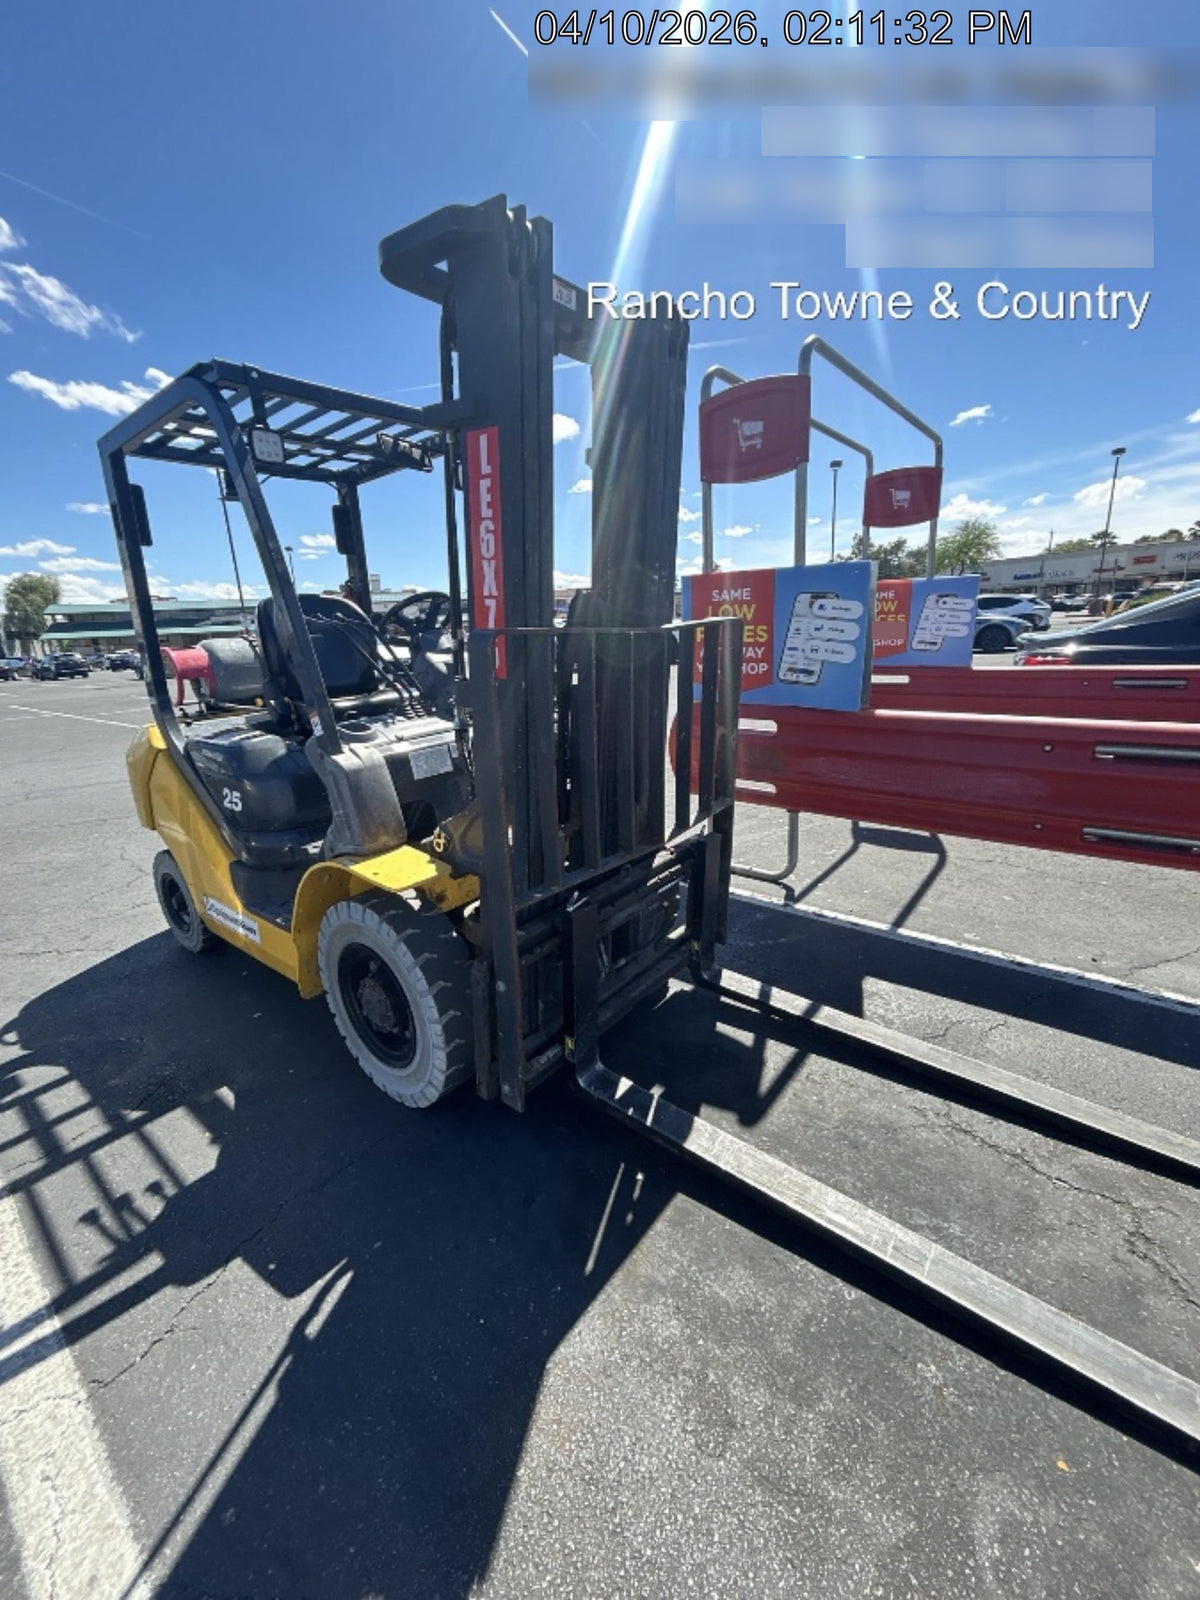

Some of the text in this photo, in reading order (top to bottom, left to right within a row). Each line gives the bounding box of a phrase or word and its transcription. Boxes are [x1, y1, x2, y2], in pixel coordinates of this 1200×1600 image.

[479, 433, 500, 670] LE6X7
[712, 588, 751, 602] SAME
[223, 787, 242, 812] 25
